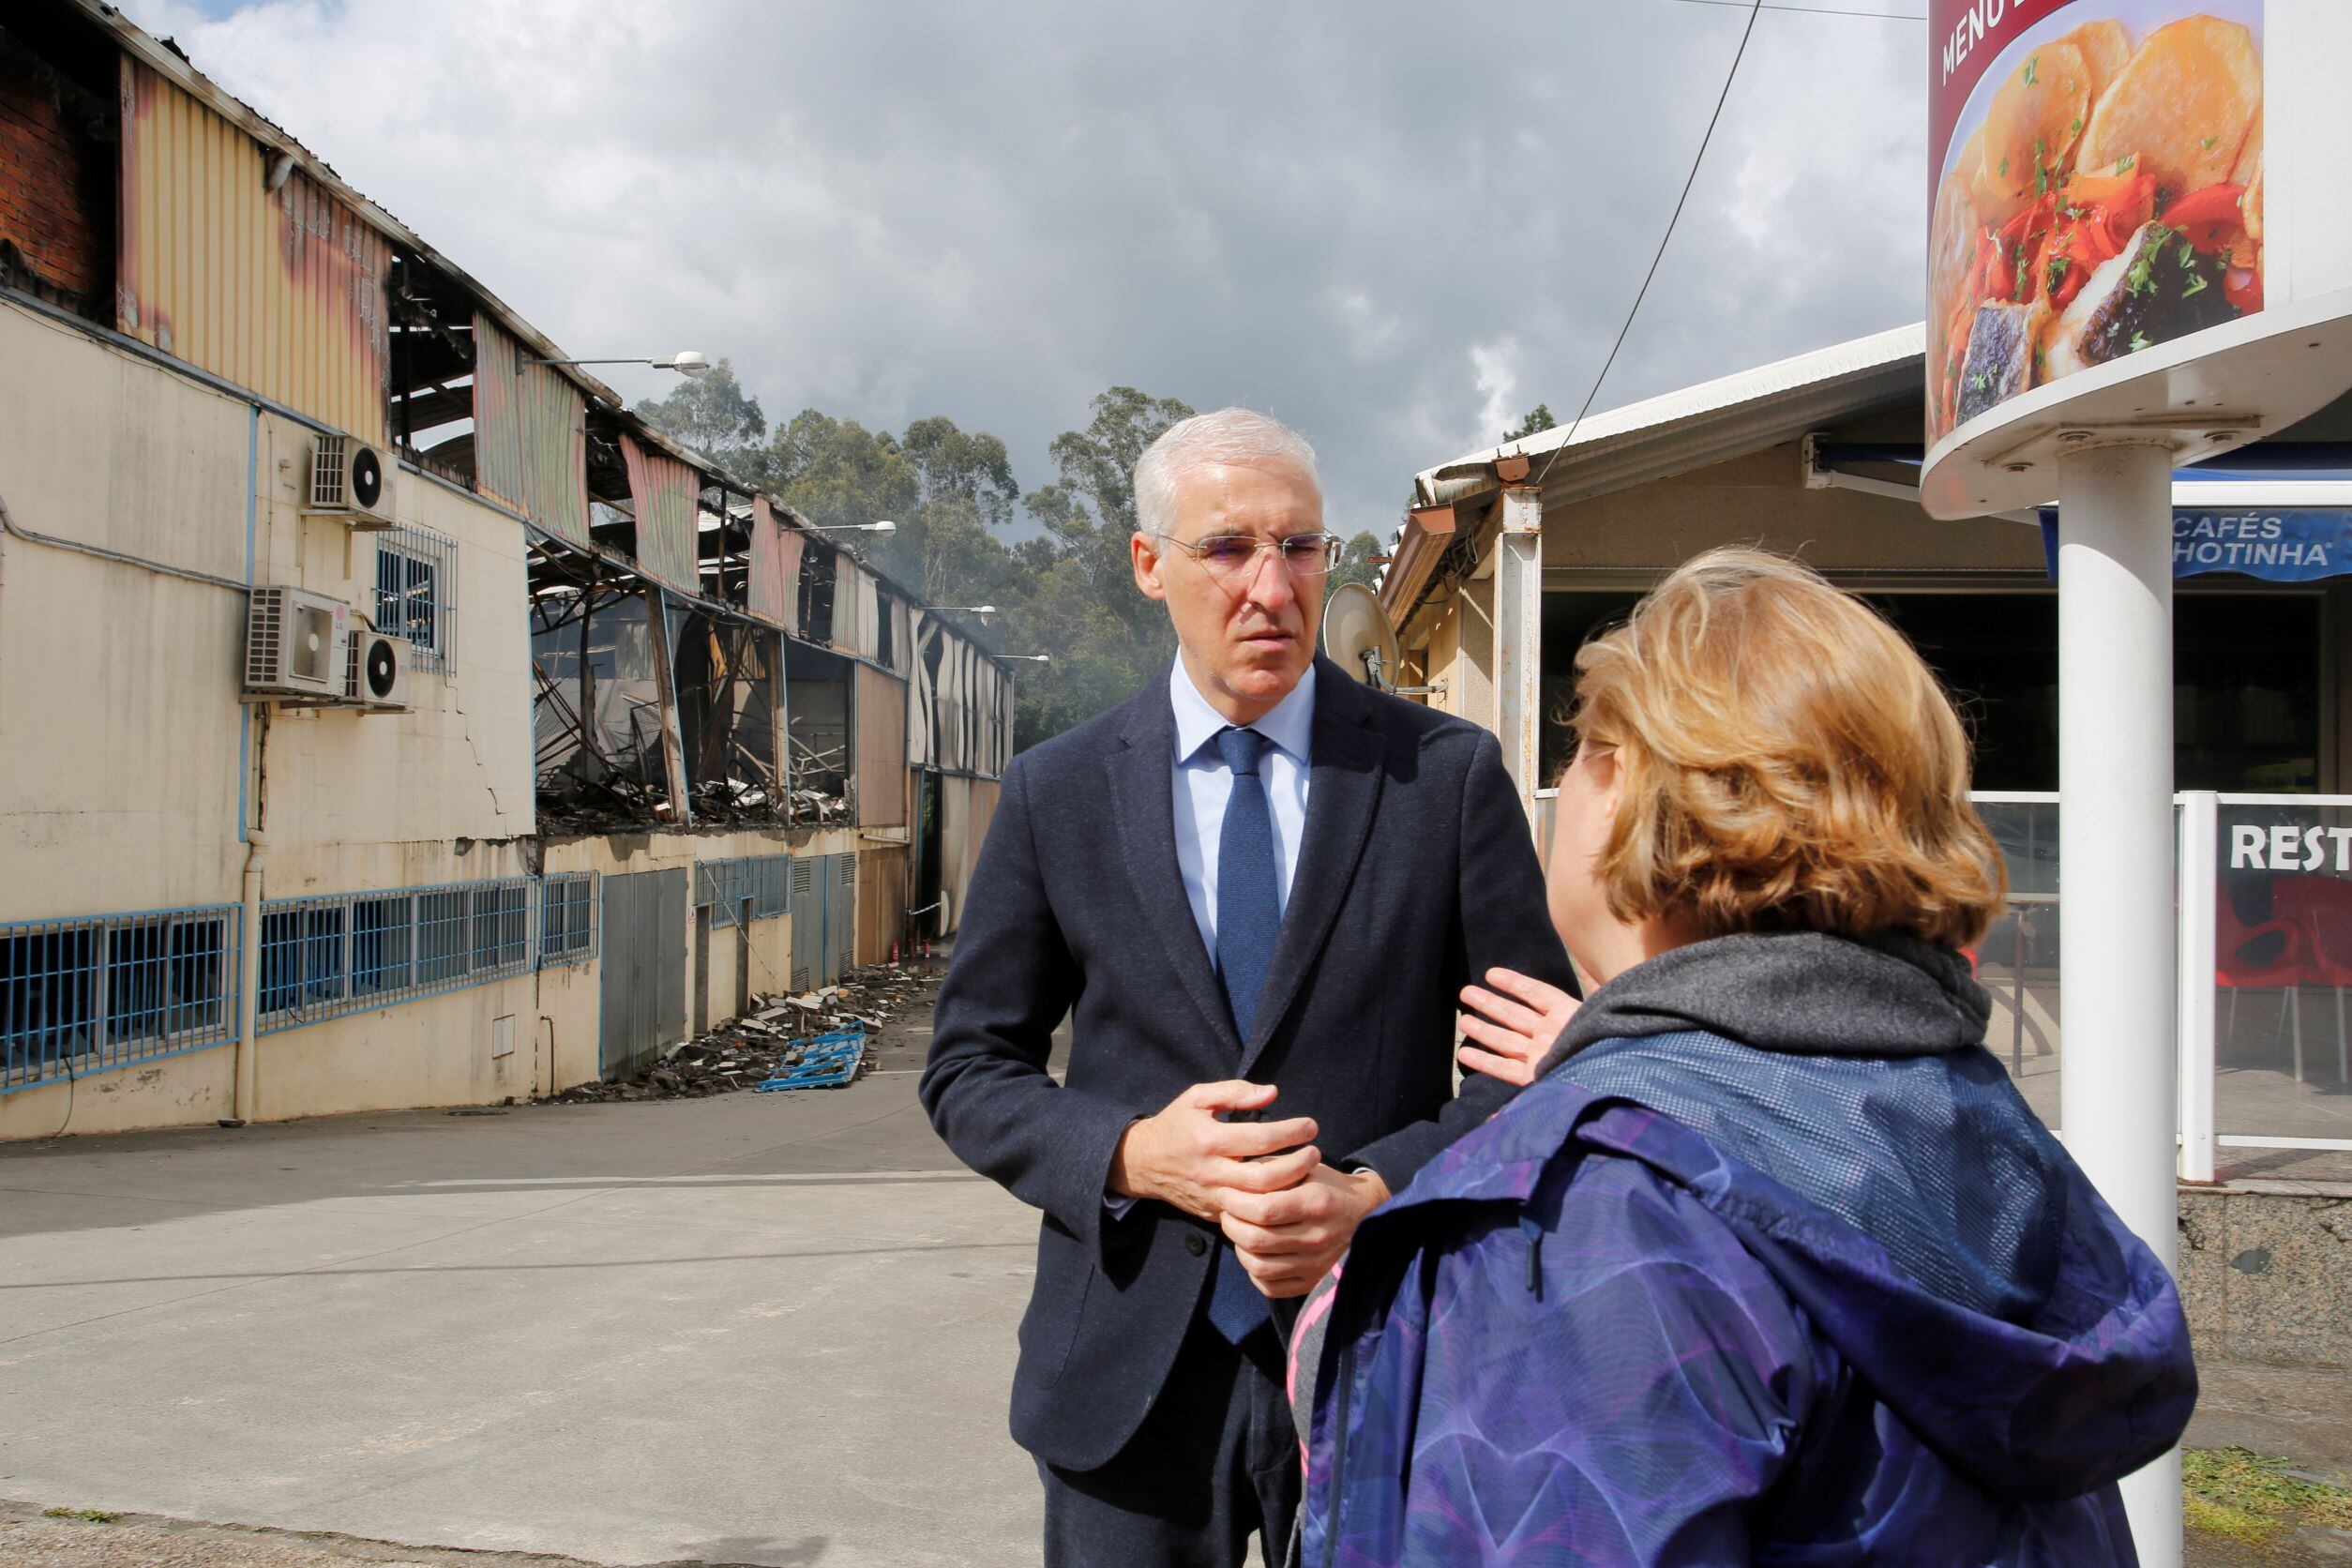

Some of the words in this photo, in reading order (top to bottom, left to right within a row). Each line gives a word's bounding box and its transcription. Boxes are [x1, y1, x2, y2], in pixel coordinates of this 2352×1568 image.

[1943, 0, 2004, 87] MENU
[2173, 512, 2283, 539] CAFÉS
[2231, 824, 2352, 872] REST
